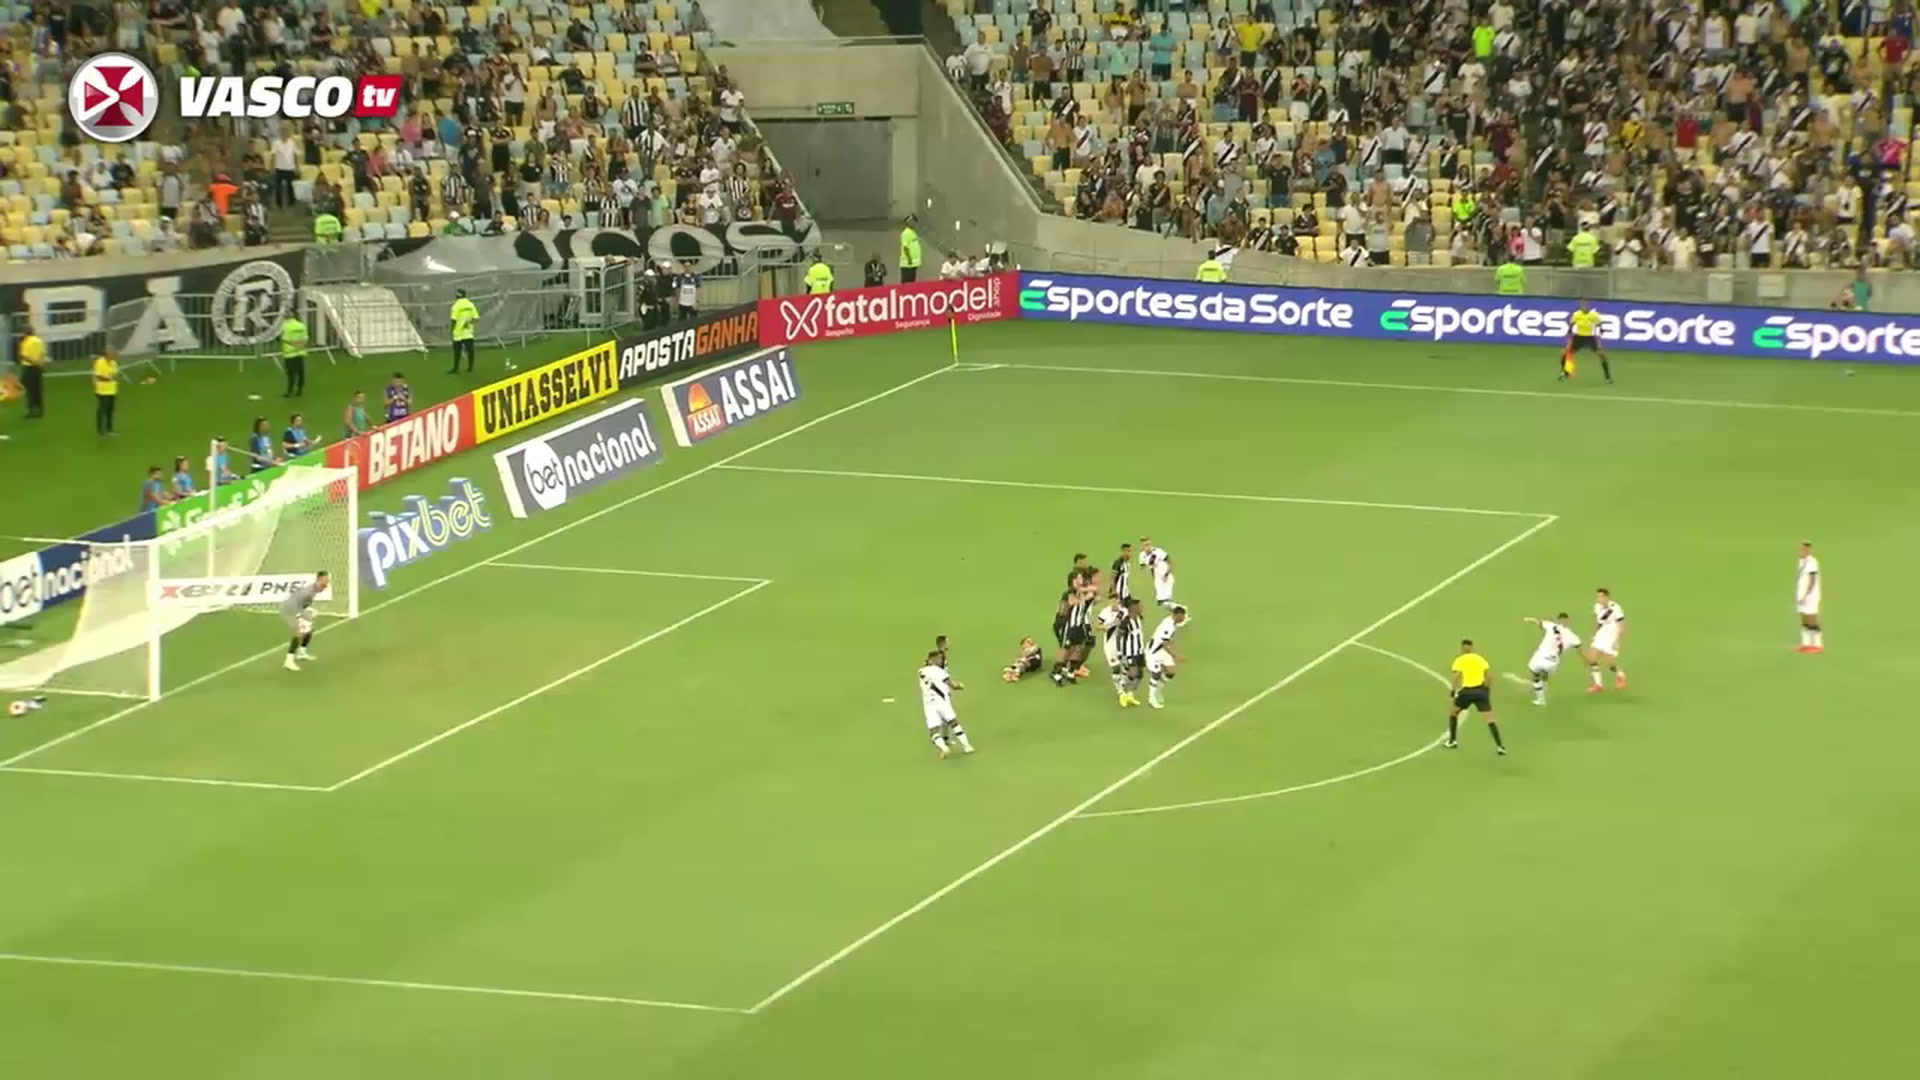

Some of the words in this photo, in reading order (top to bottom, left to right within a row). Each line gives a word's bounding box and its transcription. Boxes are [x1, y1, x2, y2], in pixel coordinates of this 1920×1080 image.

[825, 278, 993, 327] fatalmodel
[482, 348, 613, 434] UNIASSELVI
[367, 403, 460, 484] BETANO
[366, 480, 492, 588] pixbet
[260, 580, 307, 595] PNE
